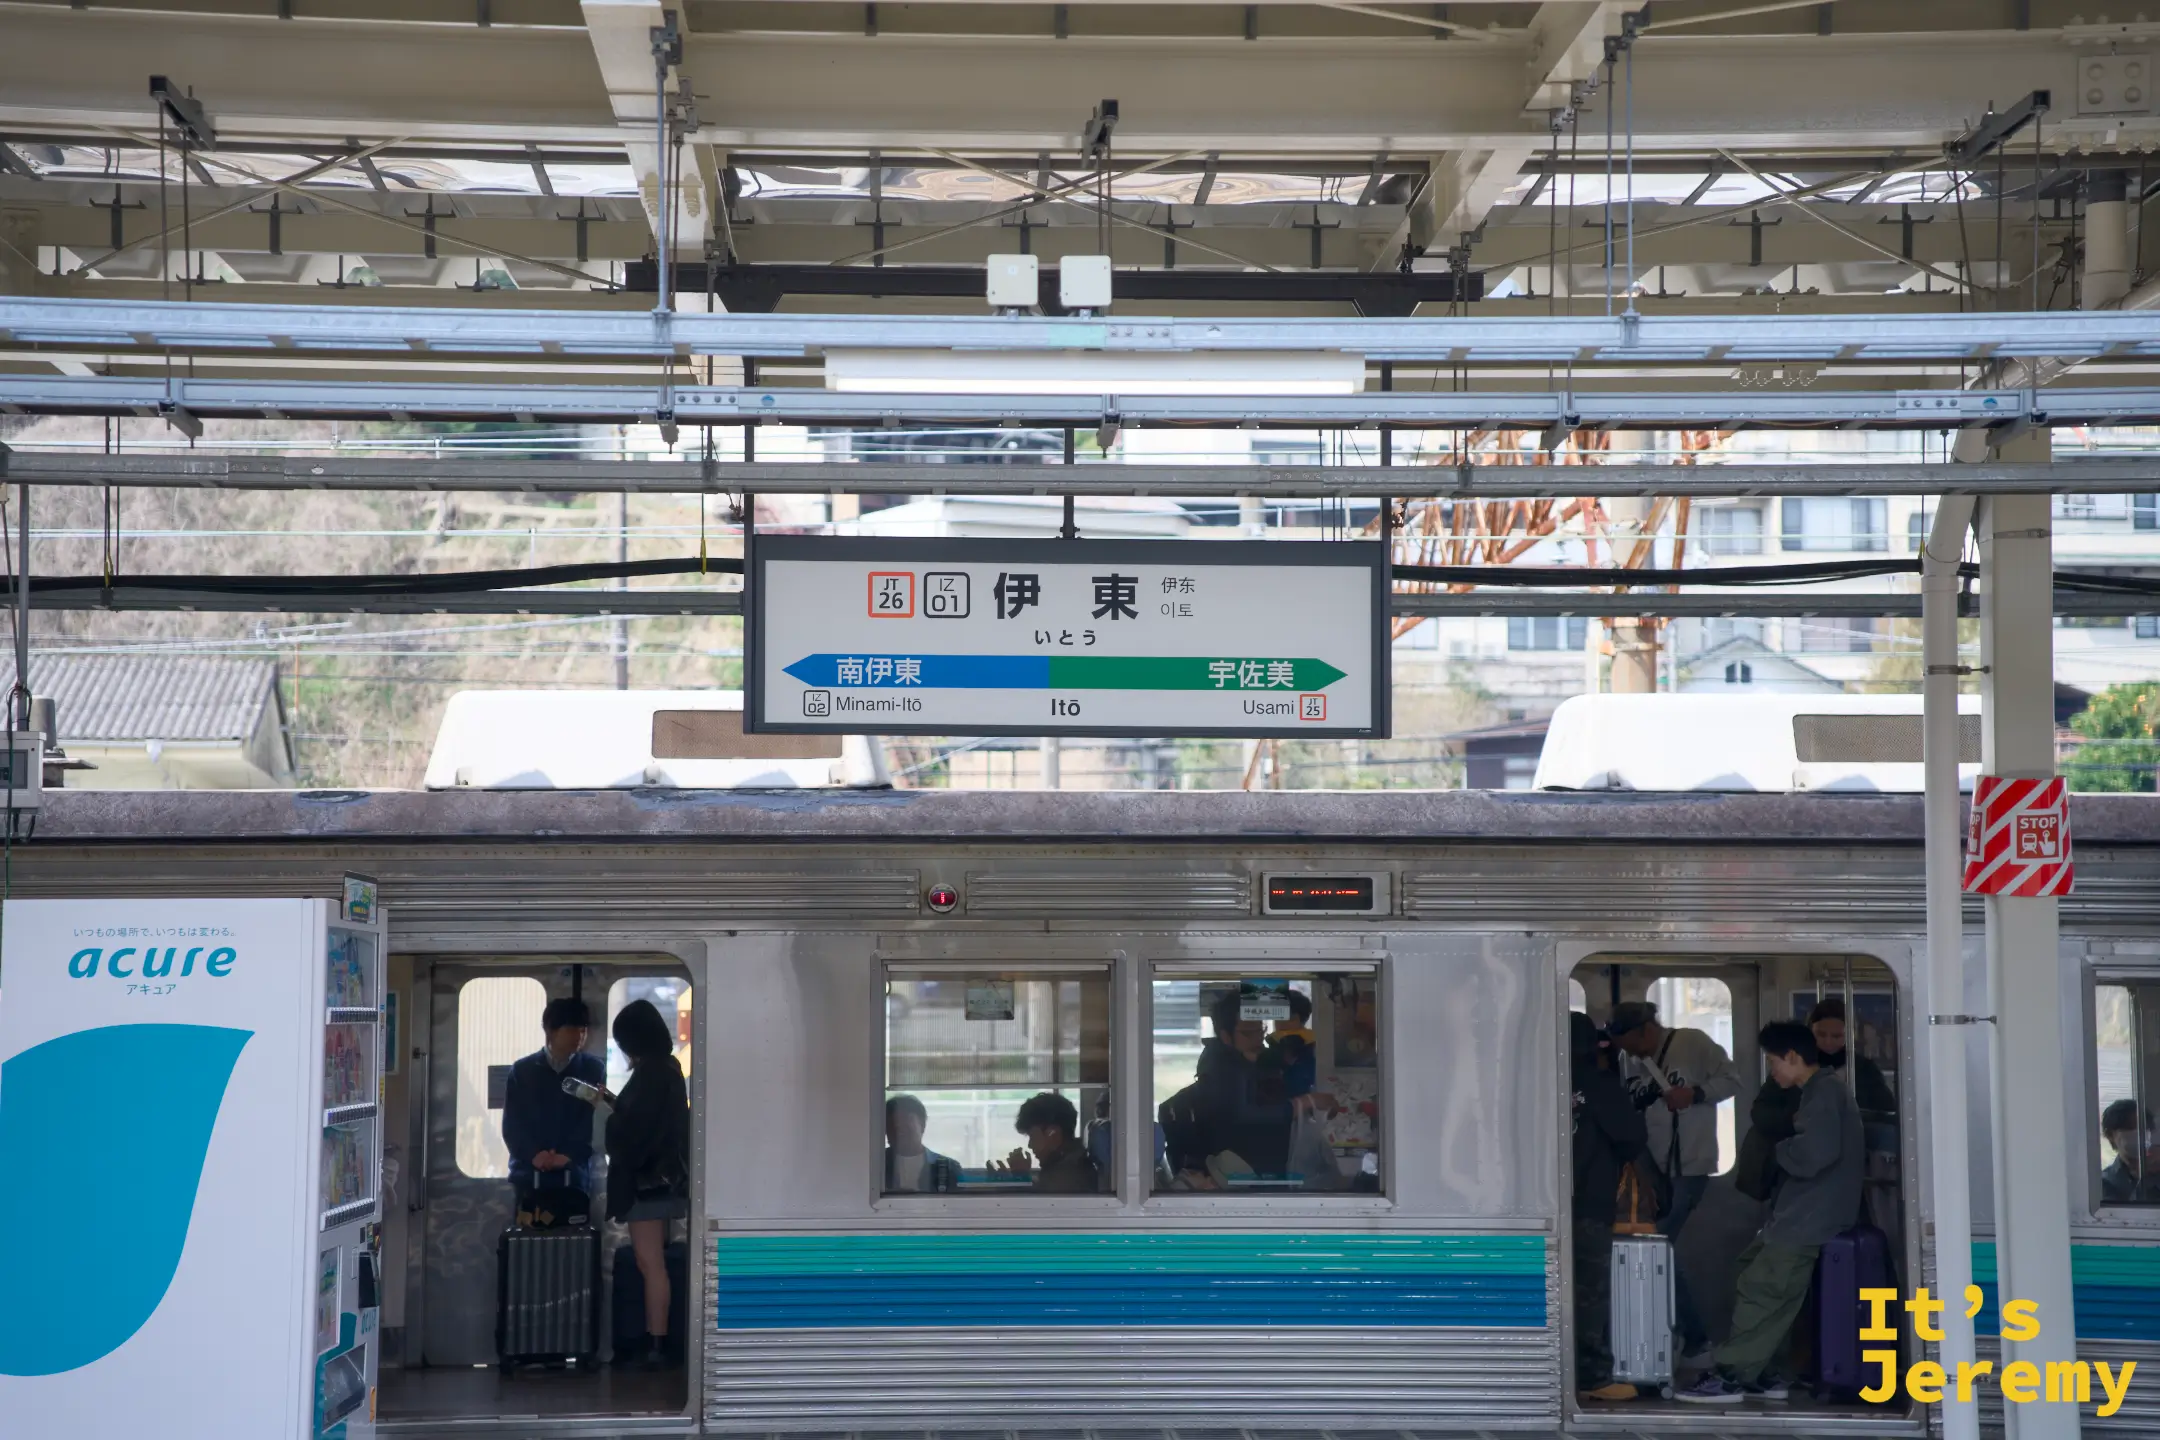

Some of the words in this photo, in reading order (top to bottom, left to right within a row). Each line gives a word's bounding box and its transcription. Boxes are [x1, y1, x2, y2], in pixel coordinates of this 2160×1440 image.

[883, 578, 900, 591] JT
[939, 578, 955, 592] IZ
[1161, 576, 1195, 594] 伊东
[878, 592, 904, 609] 26
[931, 595, 958, 612] 01
[993, 572, 1140, 620] 伊東
[1160, 601, 1194, 618] 이토
[1034, 629, 1096, 646] いとう
[836, 656, 922, 685] 南伊東
[1208, 660, 1294, 688] 宇佐美
[812, 693, 822, 702] IZ
[836, 696, 922, 712] Minami-Itō
[1308, 697, 1319, 706] JT
[807, 703, 826, 713] 02
[1051, 698, 1081, 716] Itō
[1243, 700, 1294, 715] Usami
[1306, 706, 1320, 716] 25
[2020, 817, 2057, 829] STOP
[68, 946, 237, 979] acure
[126, 983, 177, 996] アキュア
